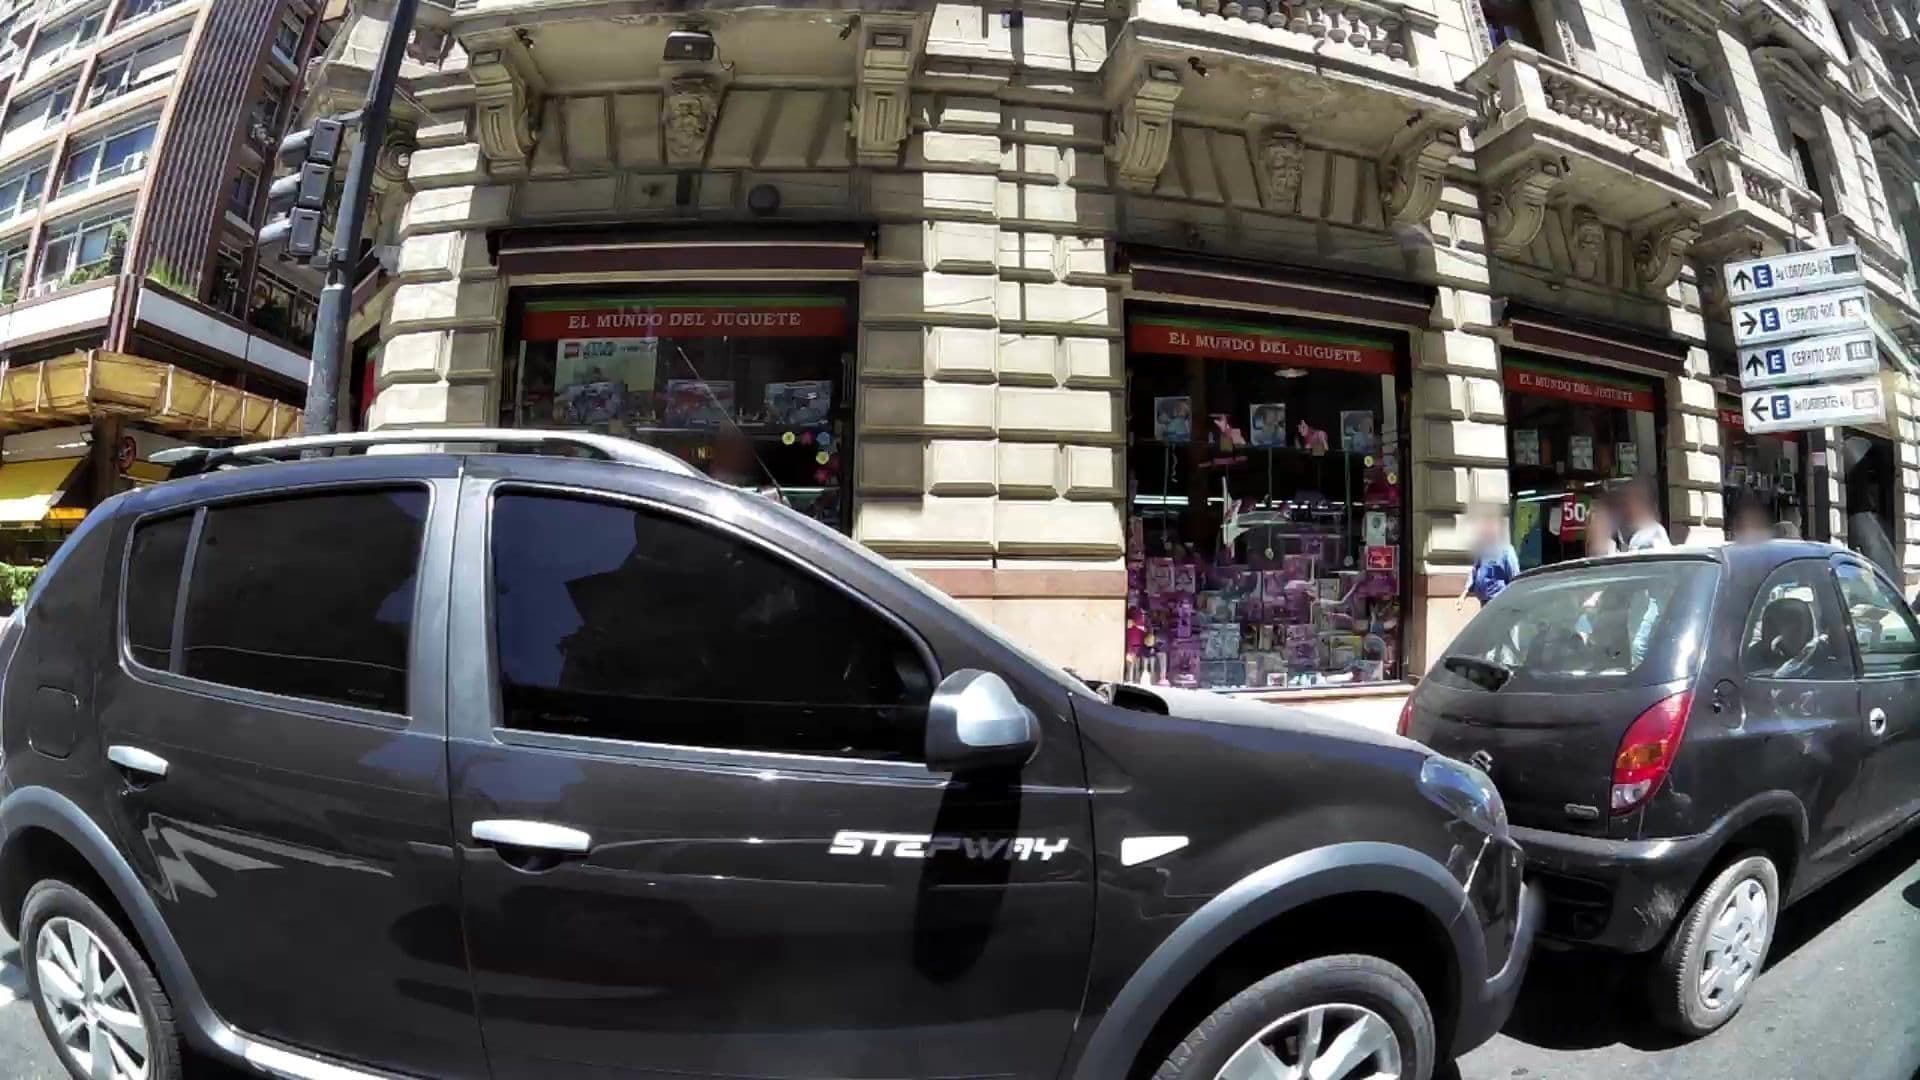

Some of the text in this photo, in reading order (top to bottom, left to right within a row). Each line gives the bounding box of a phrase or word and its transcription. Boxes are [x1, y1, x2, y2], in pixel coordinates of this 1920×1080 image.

[568, 312, 801, 329] EL MUNDO DEL JUGUETE
[1168, 332, 1361, 362] EL MUNDO DEL JUGUETE
[1791, 348, 1824, 366] CERRITO
[1519, 373, 1532, 386] EL
[1535, 376, 1571, 393] MUNDO
[1574, 382, 1593, 396] DEL
[827, 830, 1070, 861] STEPWAY
